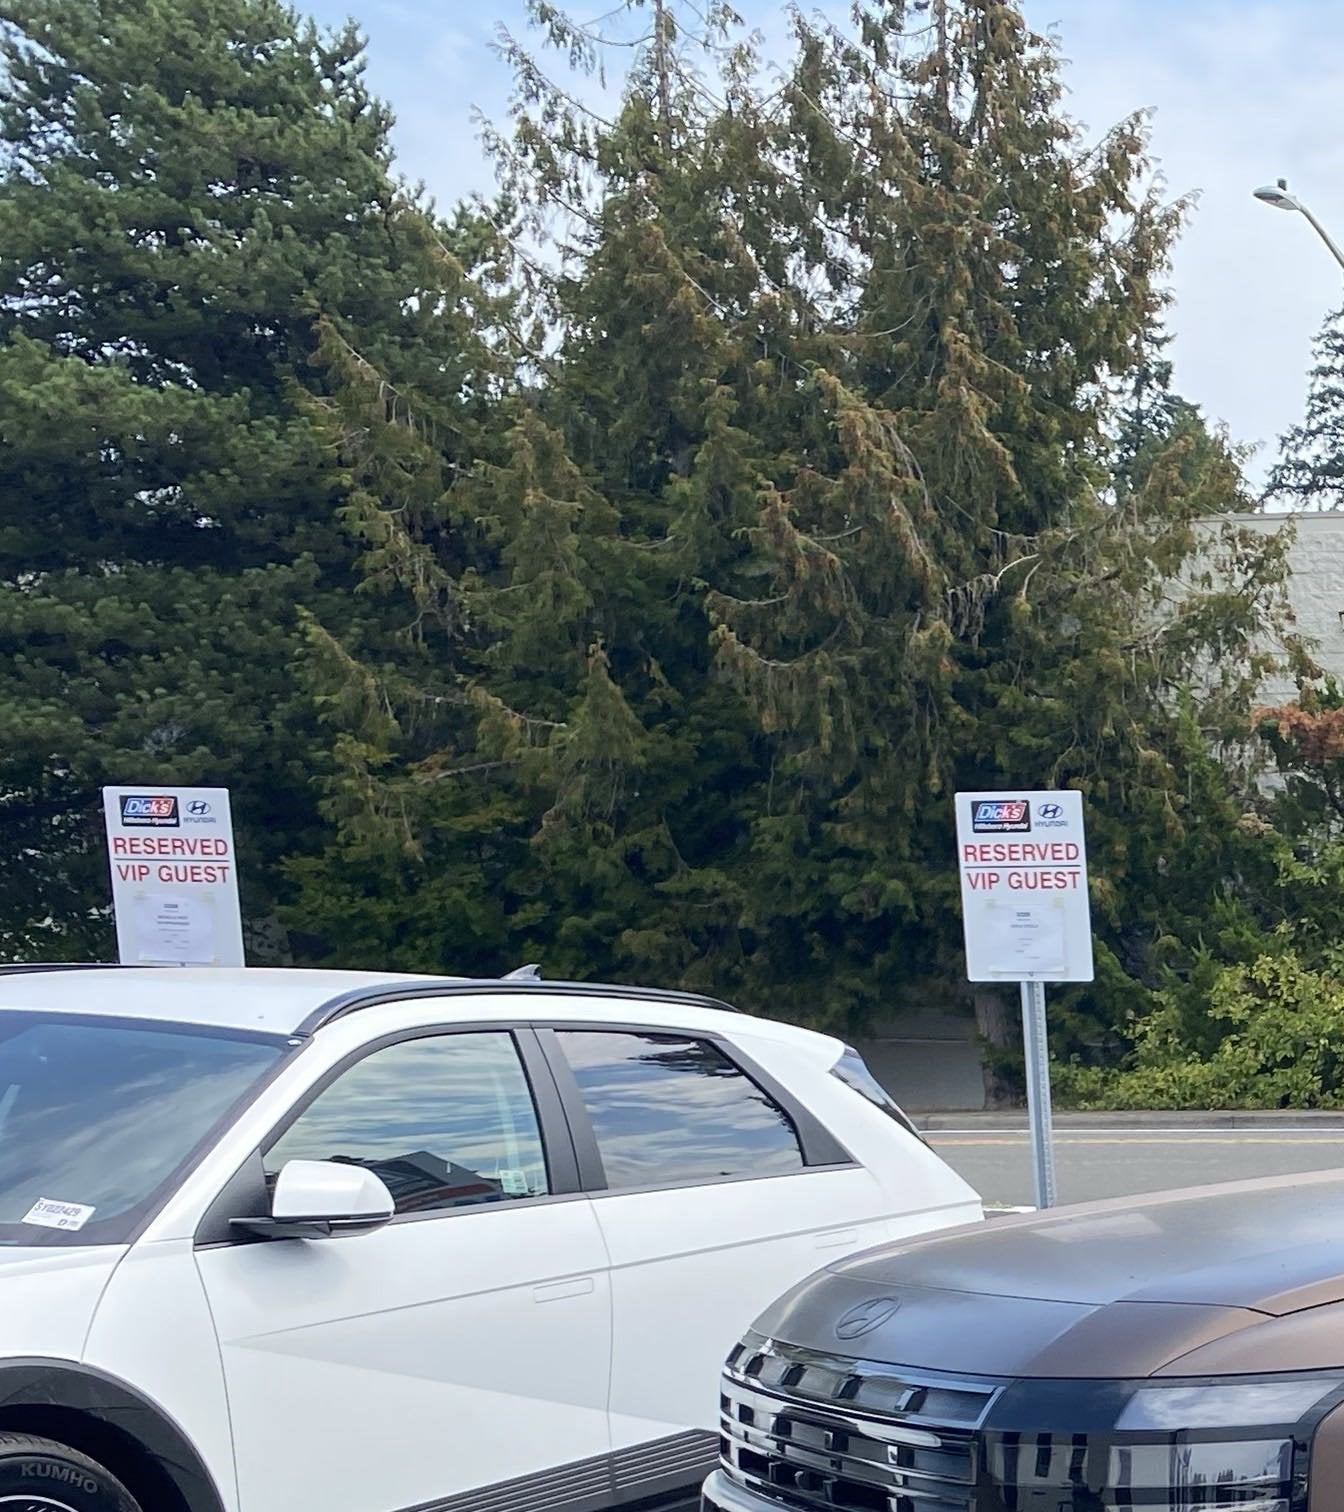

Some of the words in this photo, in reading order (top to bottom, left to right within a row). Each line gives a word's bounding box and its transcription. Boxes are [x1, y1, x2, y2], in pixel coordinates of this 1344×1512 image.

[113, 837, 229, 856] RESERVED
[963, 842, 1080, 862] RESERVED
[117, 864, 150, 882] VIP
[158, 864, 230, 883] GUEST
[966, 872, 1000, 890] VIP
[1008, 871, 1080, 889] GUEST
[21, 1463, 98, 1494] KUMHO
